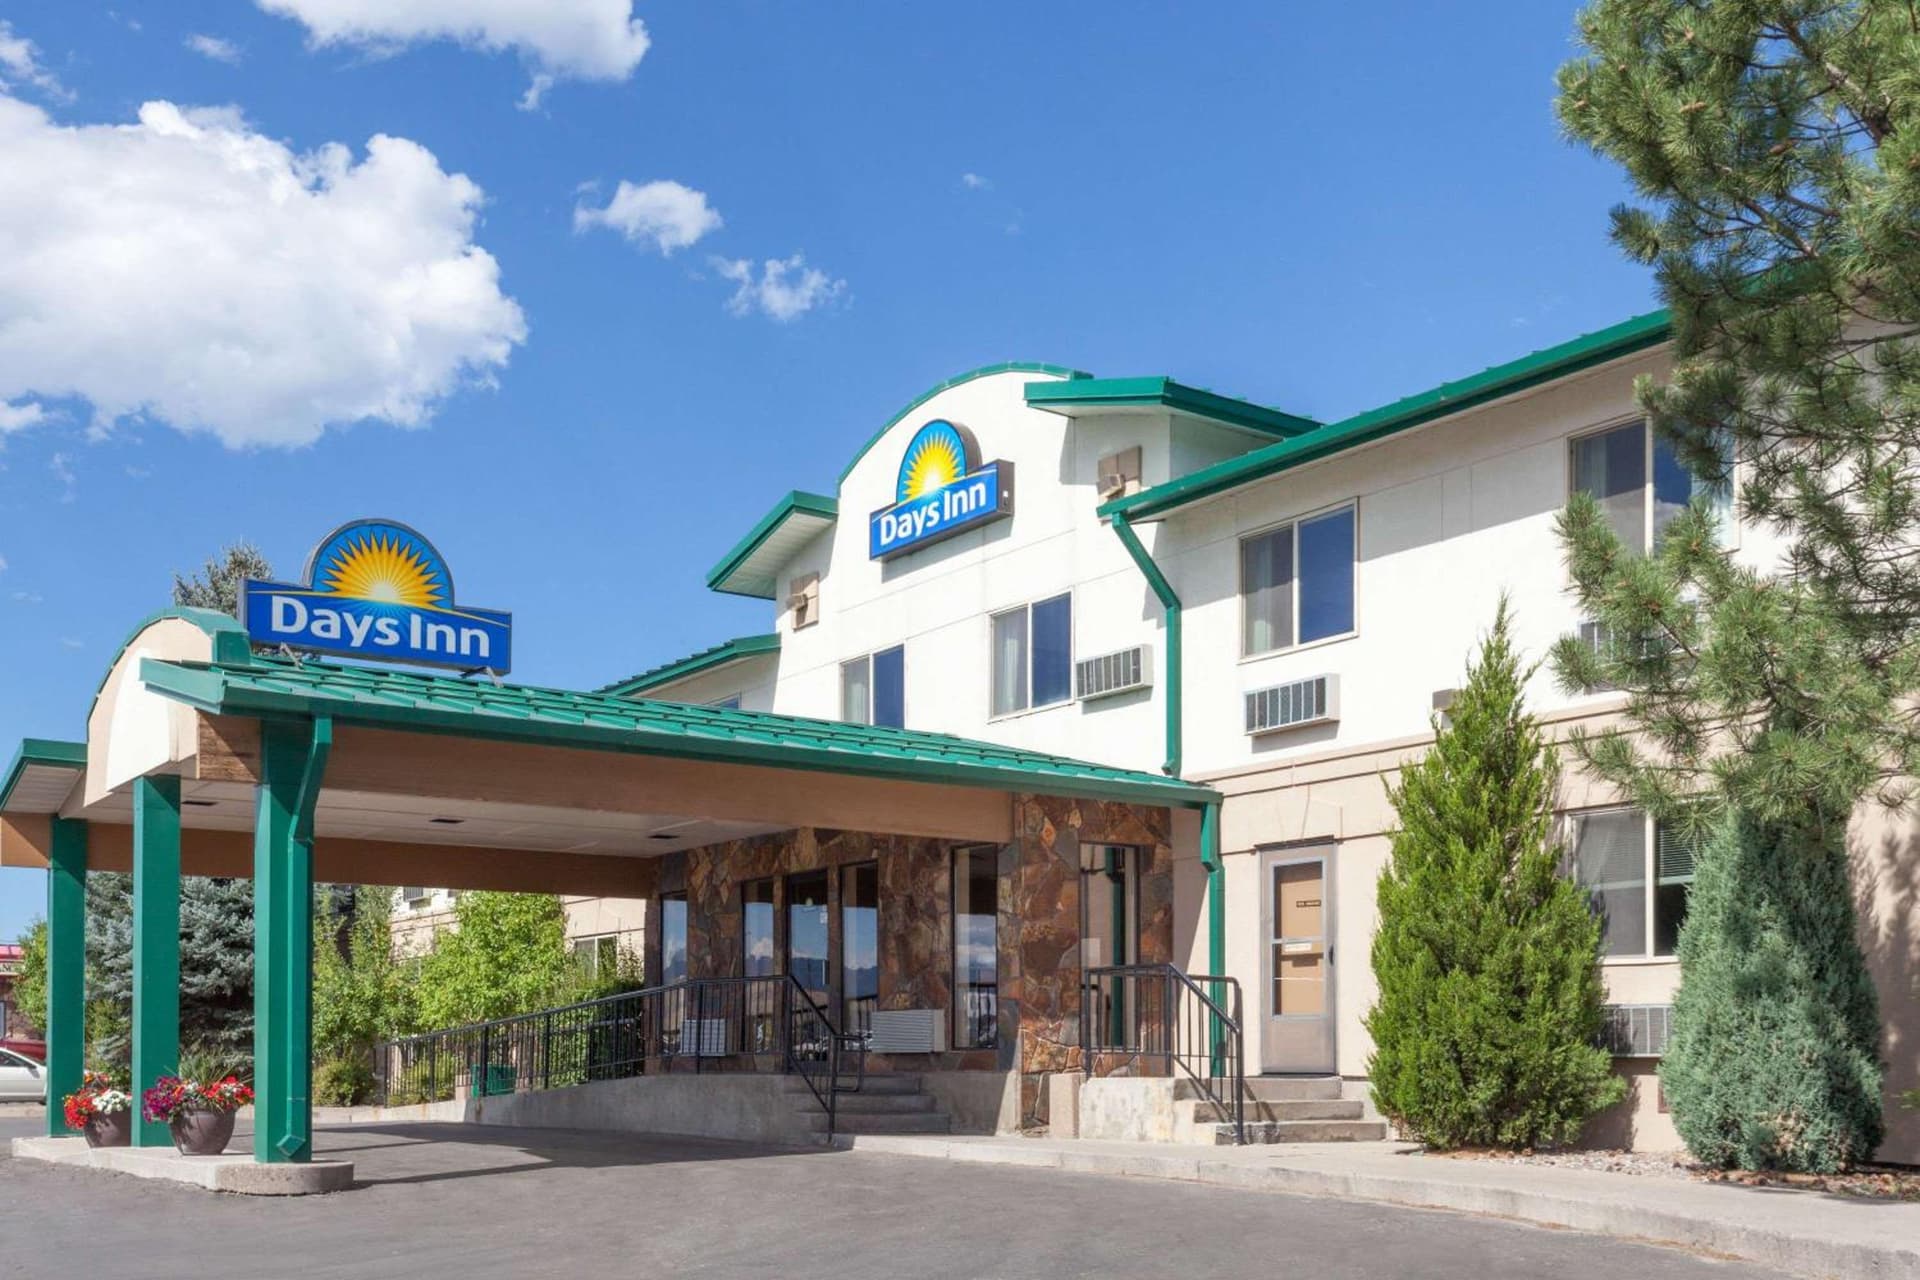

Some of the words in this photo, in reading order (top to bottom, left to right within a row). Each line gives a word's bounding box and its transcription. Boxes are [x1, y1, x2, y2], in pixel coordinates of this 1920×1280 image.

[881, 502, 941, 546] Days
[943, 481, 986, 521] Inn
[271, 595, 400, 647] Days
[410, 613, 490, 657] Inn
